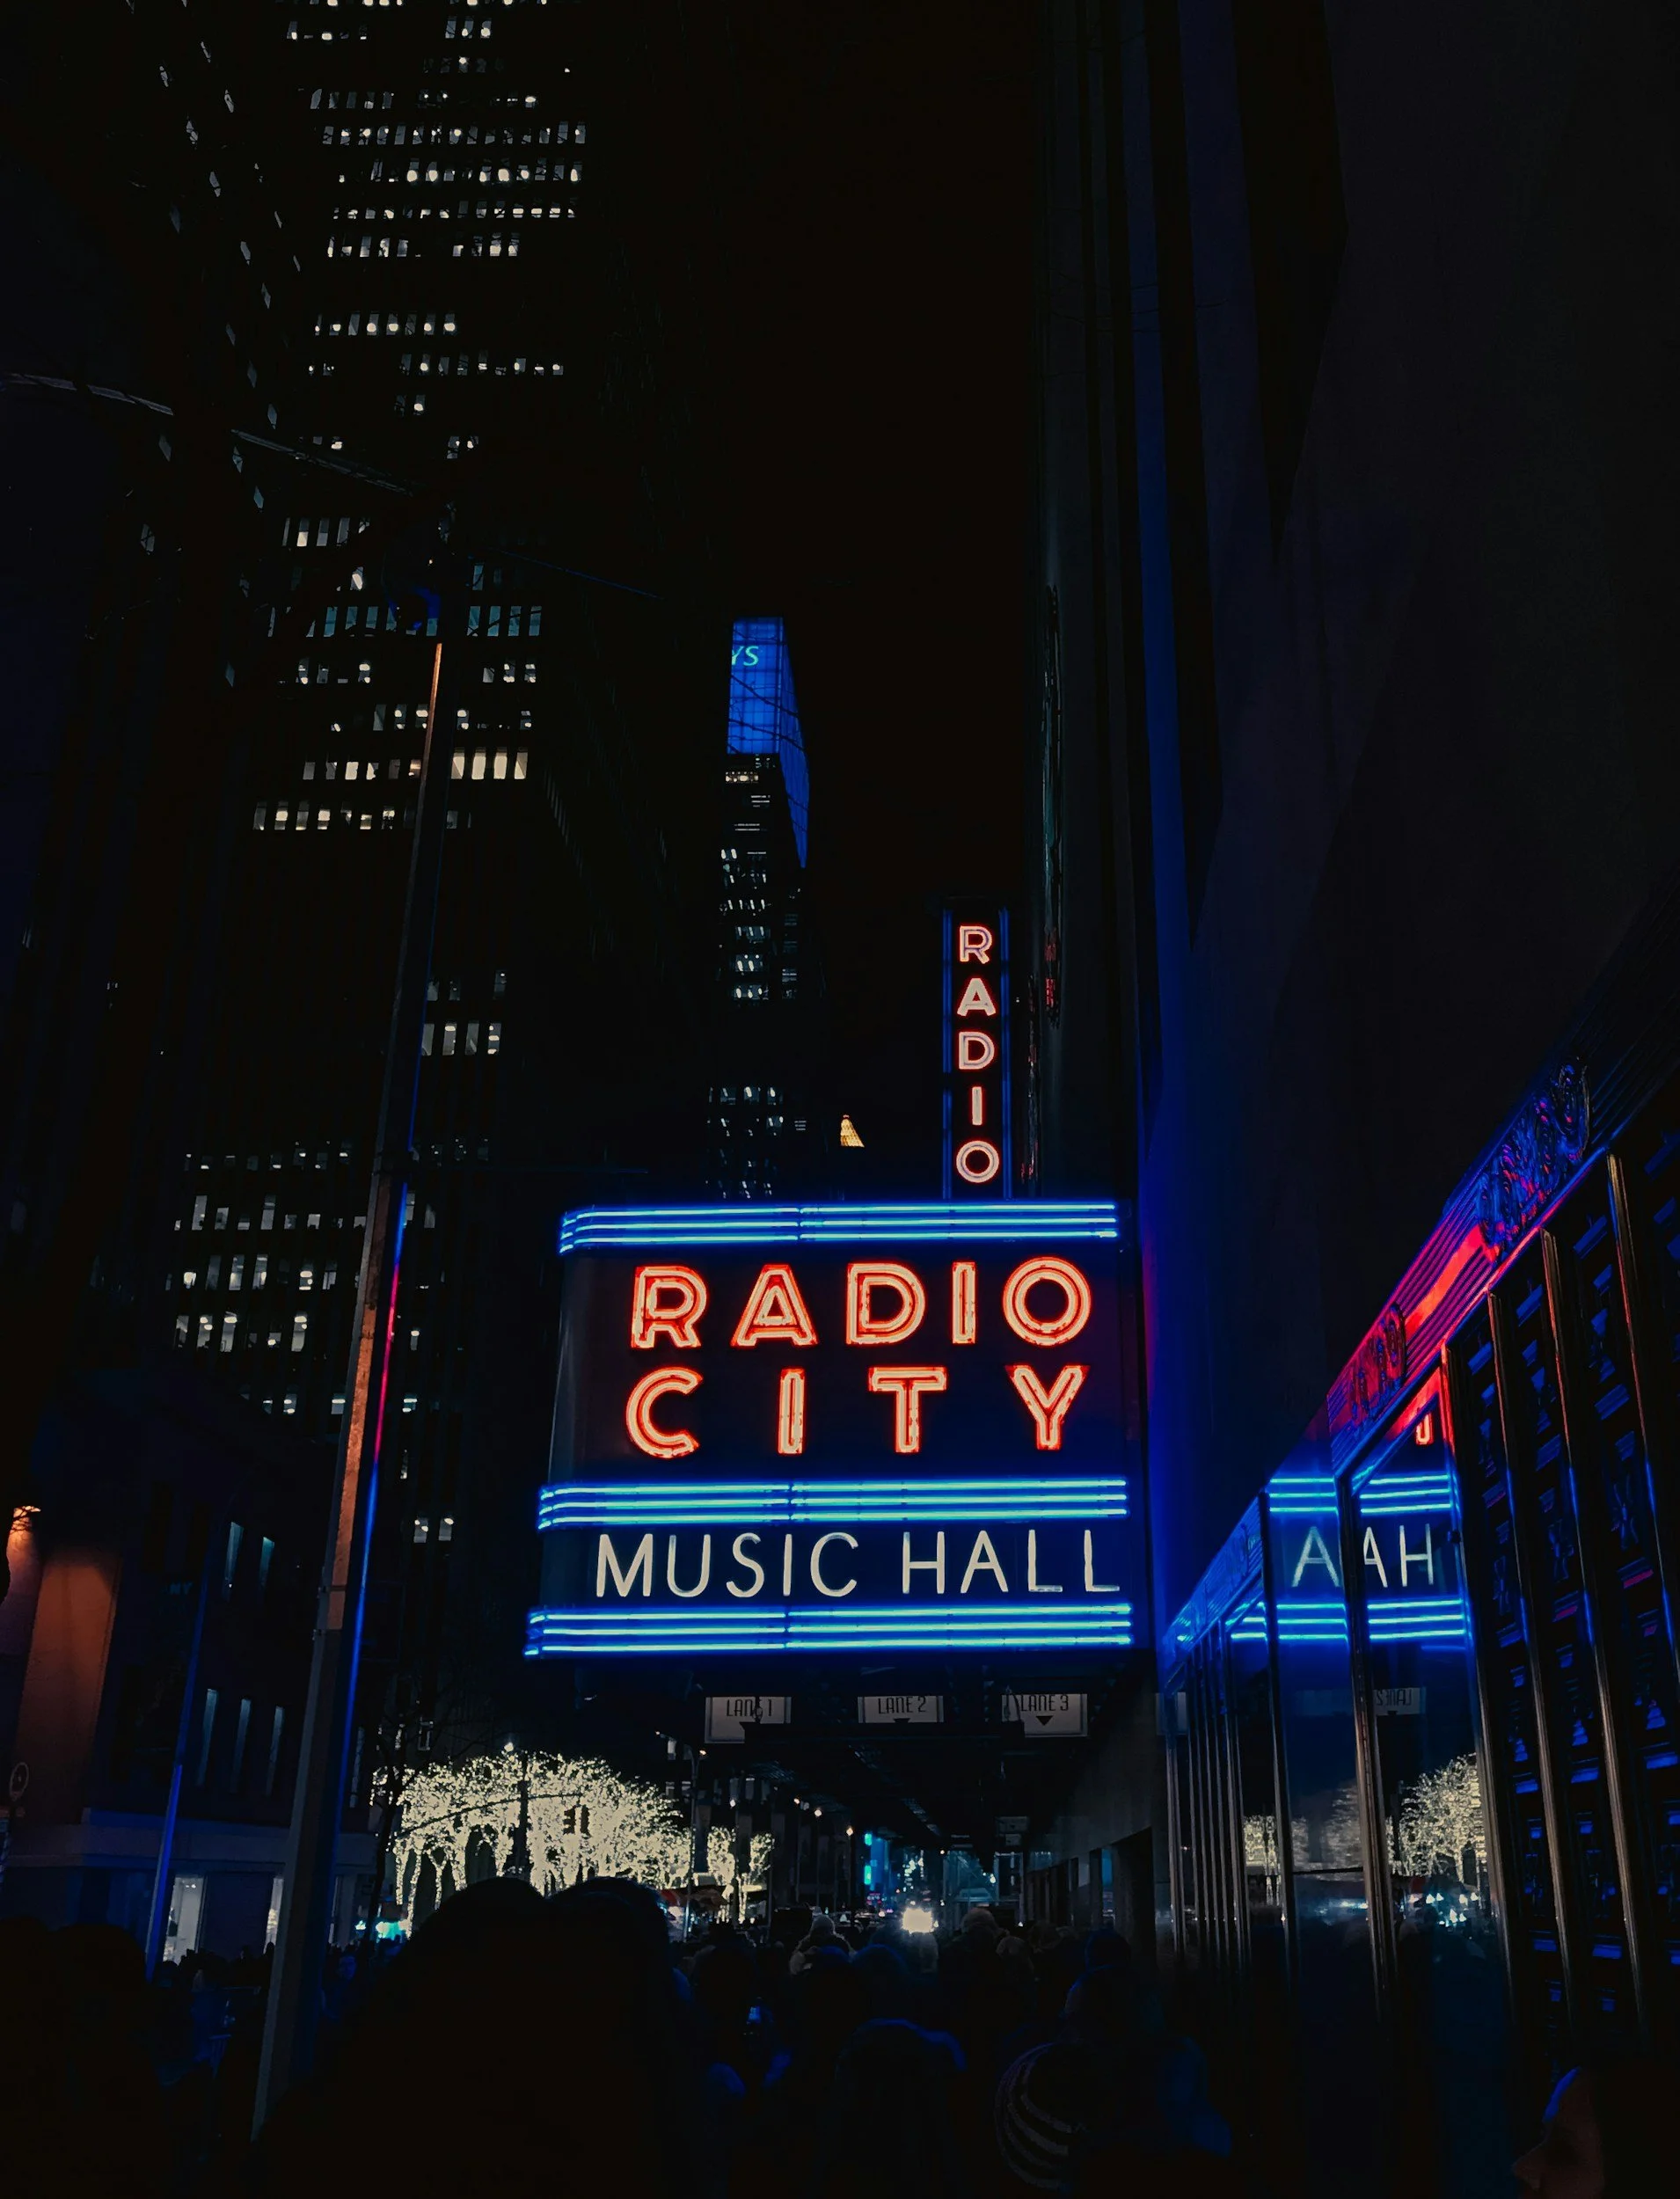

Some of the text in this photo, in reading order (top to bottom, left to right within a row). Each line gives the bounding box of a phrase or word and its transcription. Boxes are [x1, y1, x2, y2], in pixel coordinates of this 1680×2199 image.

[956, 924, 1000, 1184] RADIO
[630, 1256, 1092, 1349] RADIO
[625, 1363, 1090, 1459] CITY
[595, 1528, 1121, 1598] MUSIC HALL
[727, 1699, 773, 1717] LAN 1
[878, 1696, 927, 1714] LANE 2
[1020, 1694, 1070, 1712] LANE 3
